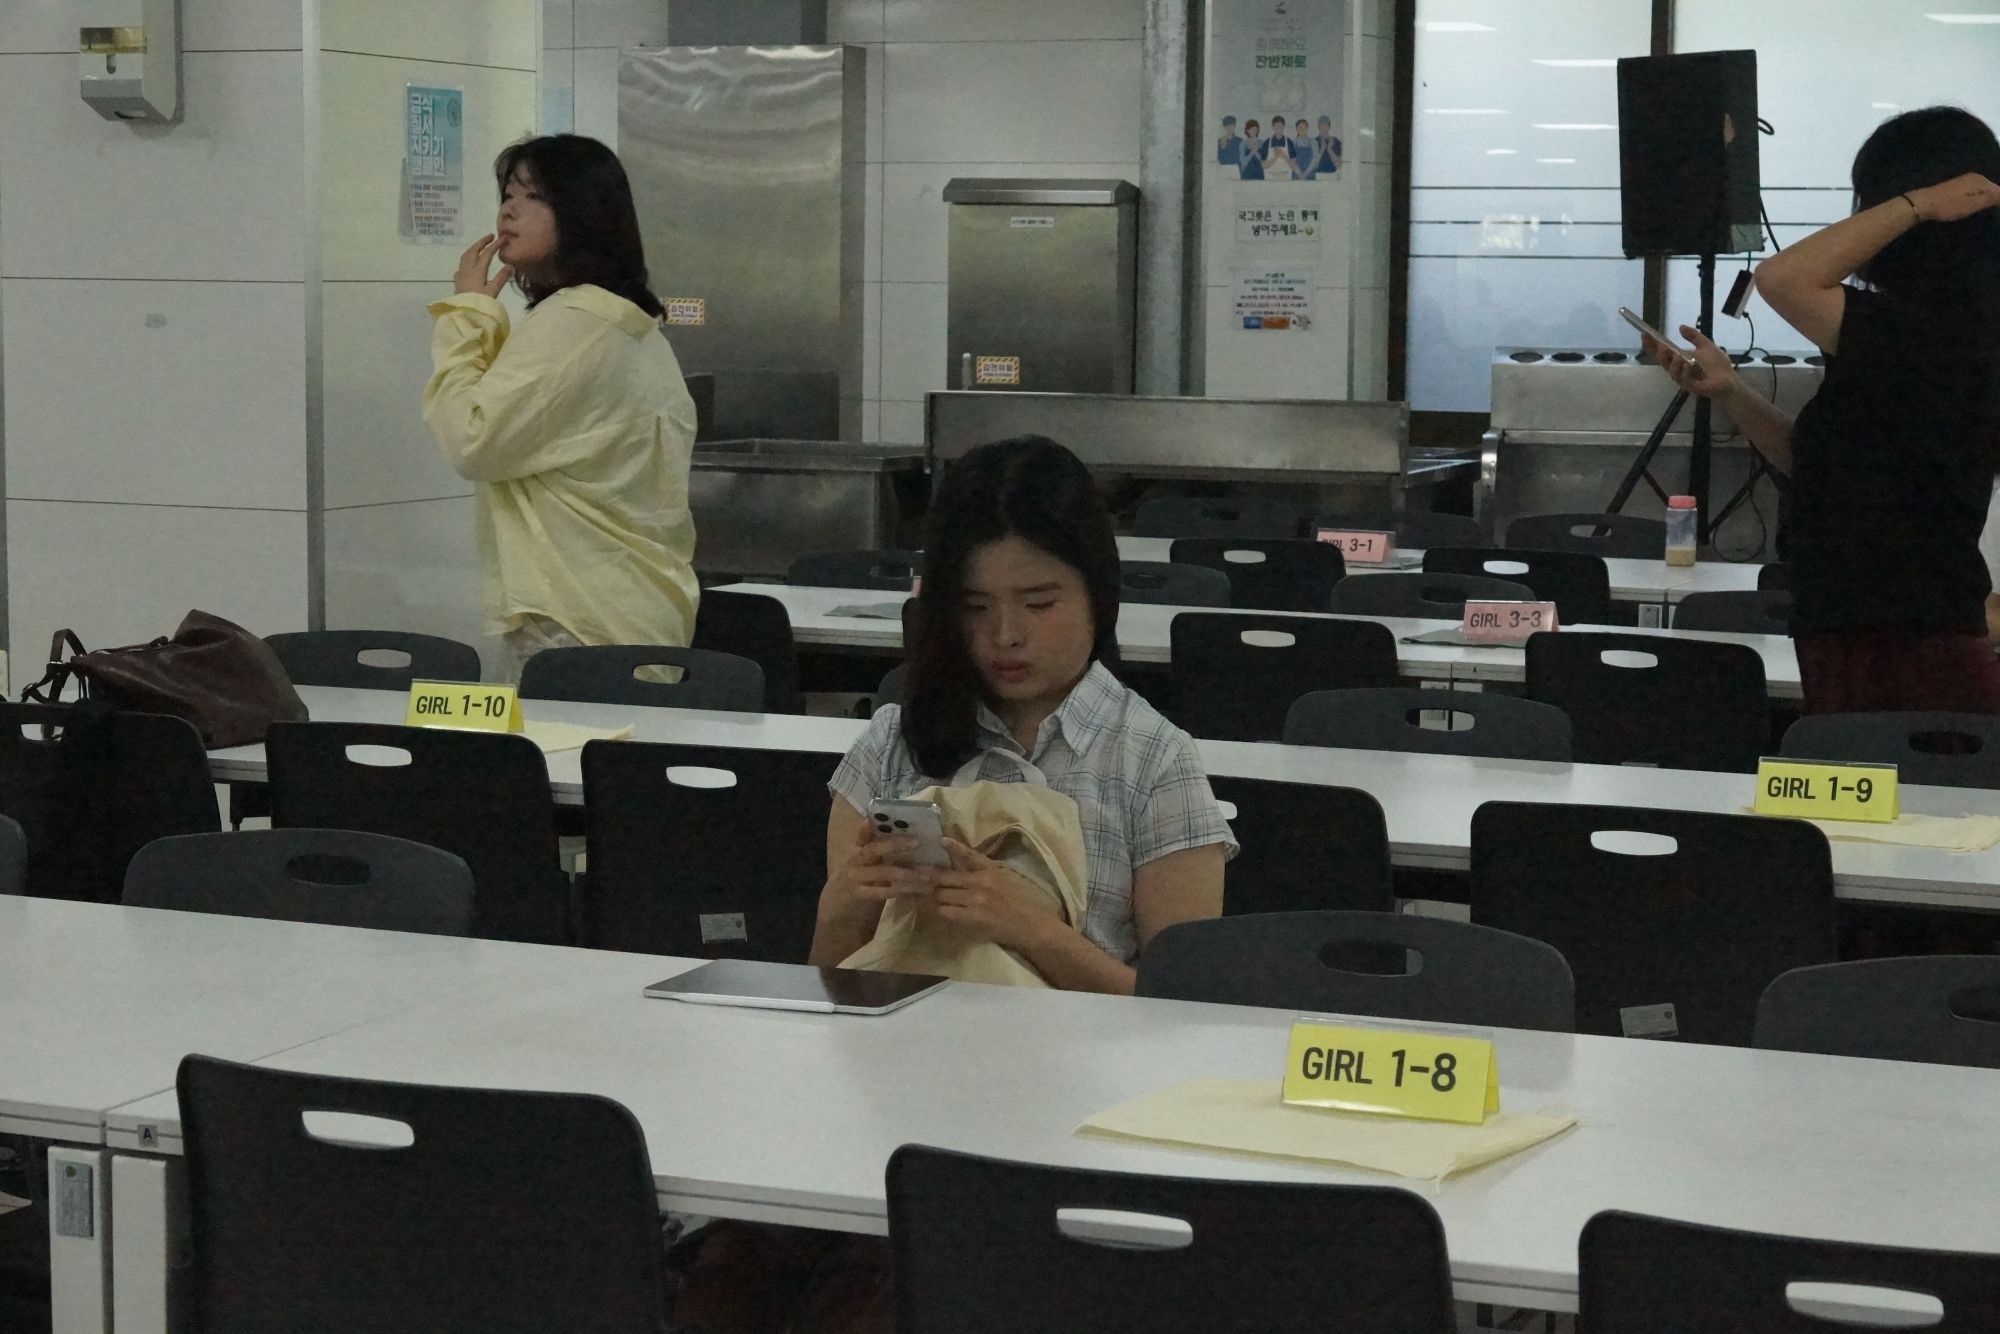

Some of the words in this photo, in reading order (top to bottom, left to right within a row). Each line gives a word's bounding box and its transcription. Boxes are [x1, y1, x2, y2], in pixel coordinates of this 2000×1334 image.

[1256, 55, 1306, 69] 잔반제로
[1238, 210, 1272, 221] 국그릇은
[1279, 210, 1295, 221] 노란
[1349, 538, 1373, 552] 3-1
[1470, 613, 1502, 628] GIRL
[1509, 610, 1542, 628] 3-3
[416, 696, 453, 715] GIRL
[462, 694, 506, 718] 1-10
[1767, 776, 1816, 799] GIRL
[1828, 776, 1873, 803] 1-9
[1302, 1046, 1373, 1085] GIRL
[1391, 1049, 1457, 1092] 1-8
[143, 1127, 153, 1140] A
